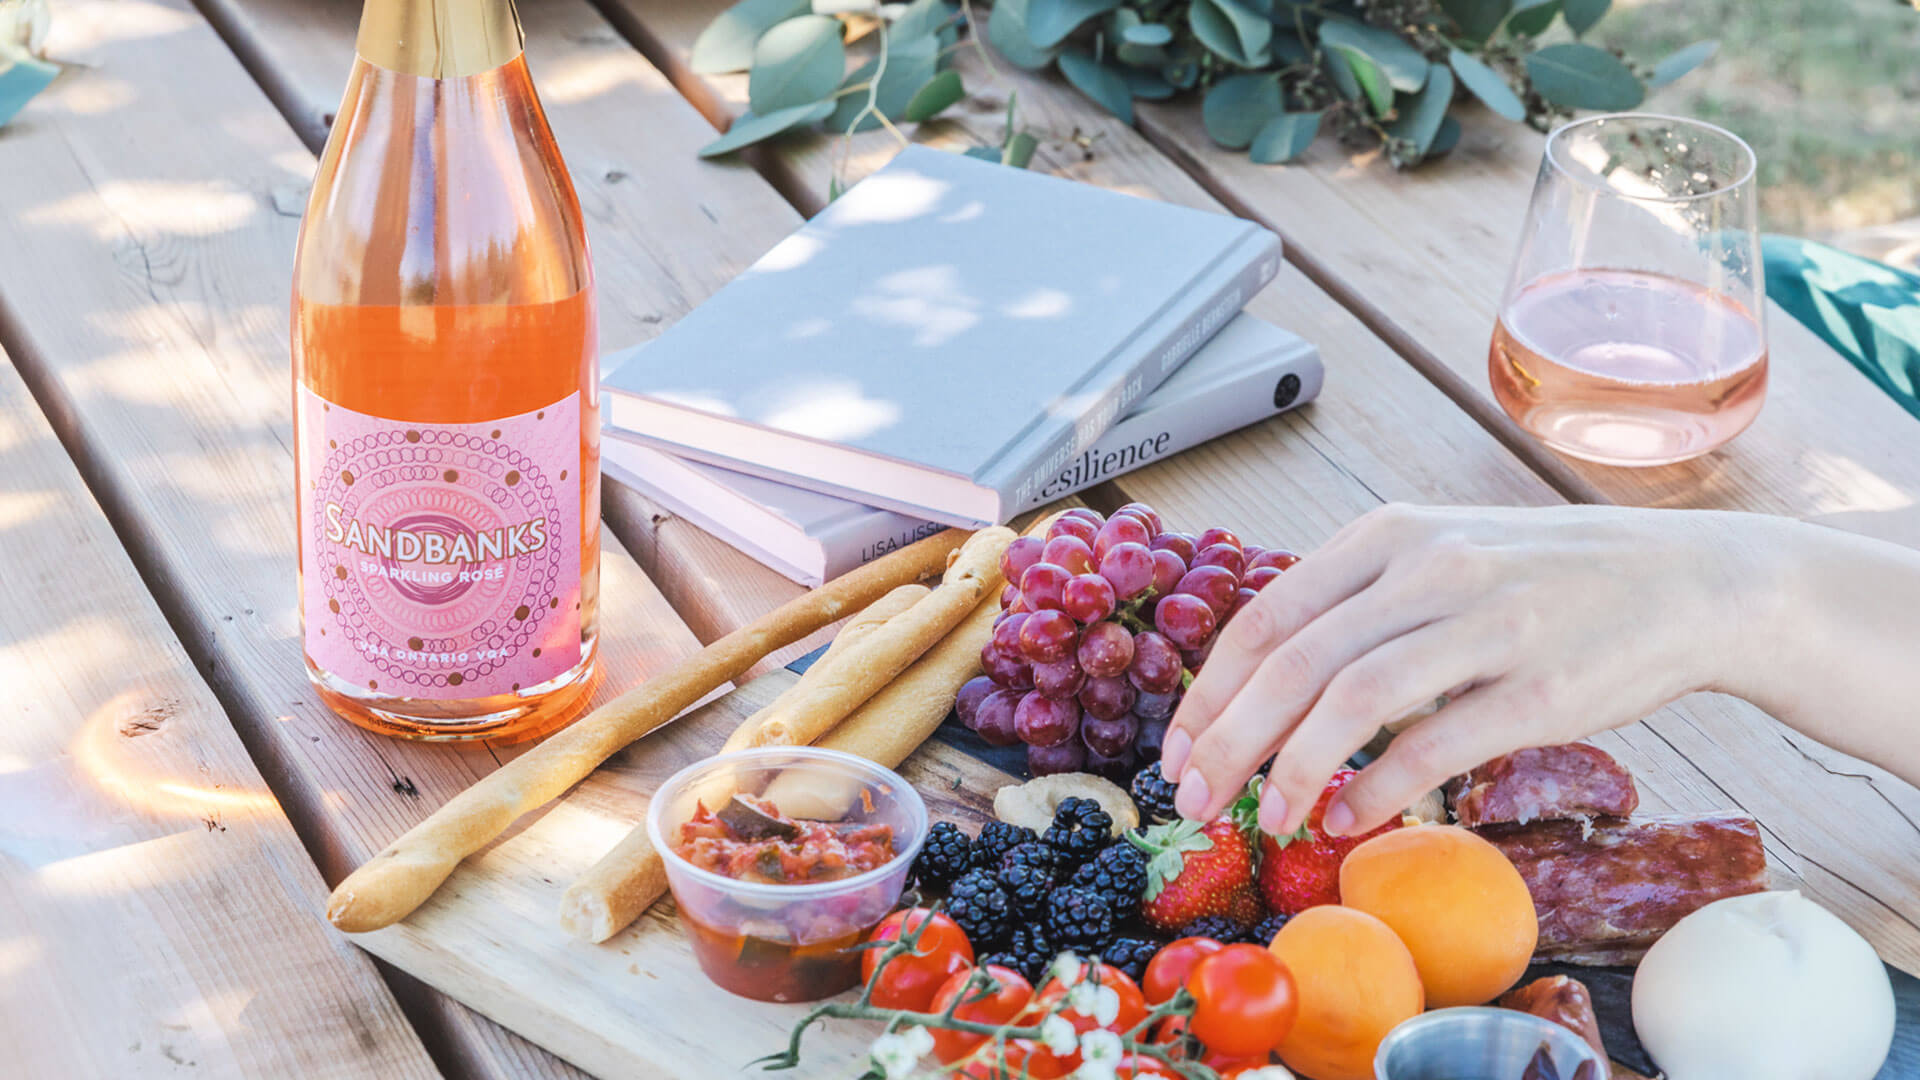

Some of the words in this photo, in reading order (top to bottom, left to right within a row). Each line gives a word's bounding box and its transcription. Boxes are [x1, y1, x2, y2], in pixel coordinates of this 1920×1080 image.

[1015, 477, 1031, 507] THE
[1033, 436, 1076, 489] UNIVERSE
[1032, 431, 1170, 502] esilience
[325, 502, 547, 565] SANDBANKS
[862, 537, 897, 562] LISA
[360, 561, 453, 583] SPARKLING
[397, 650, 469, 663] ONTARIO
